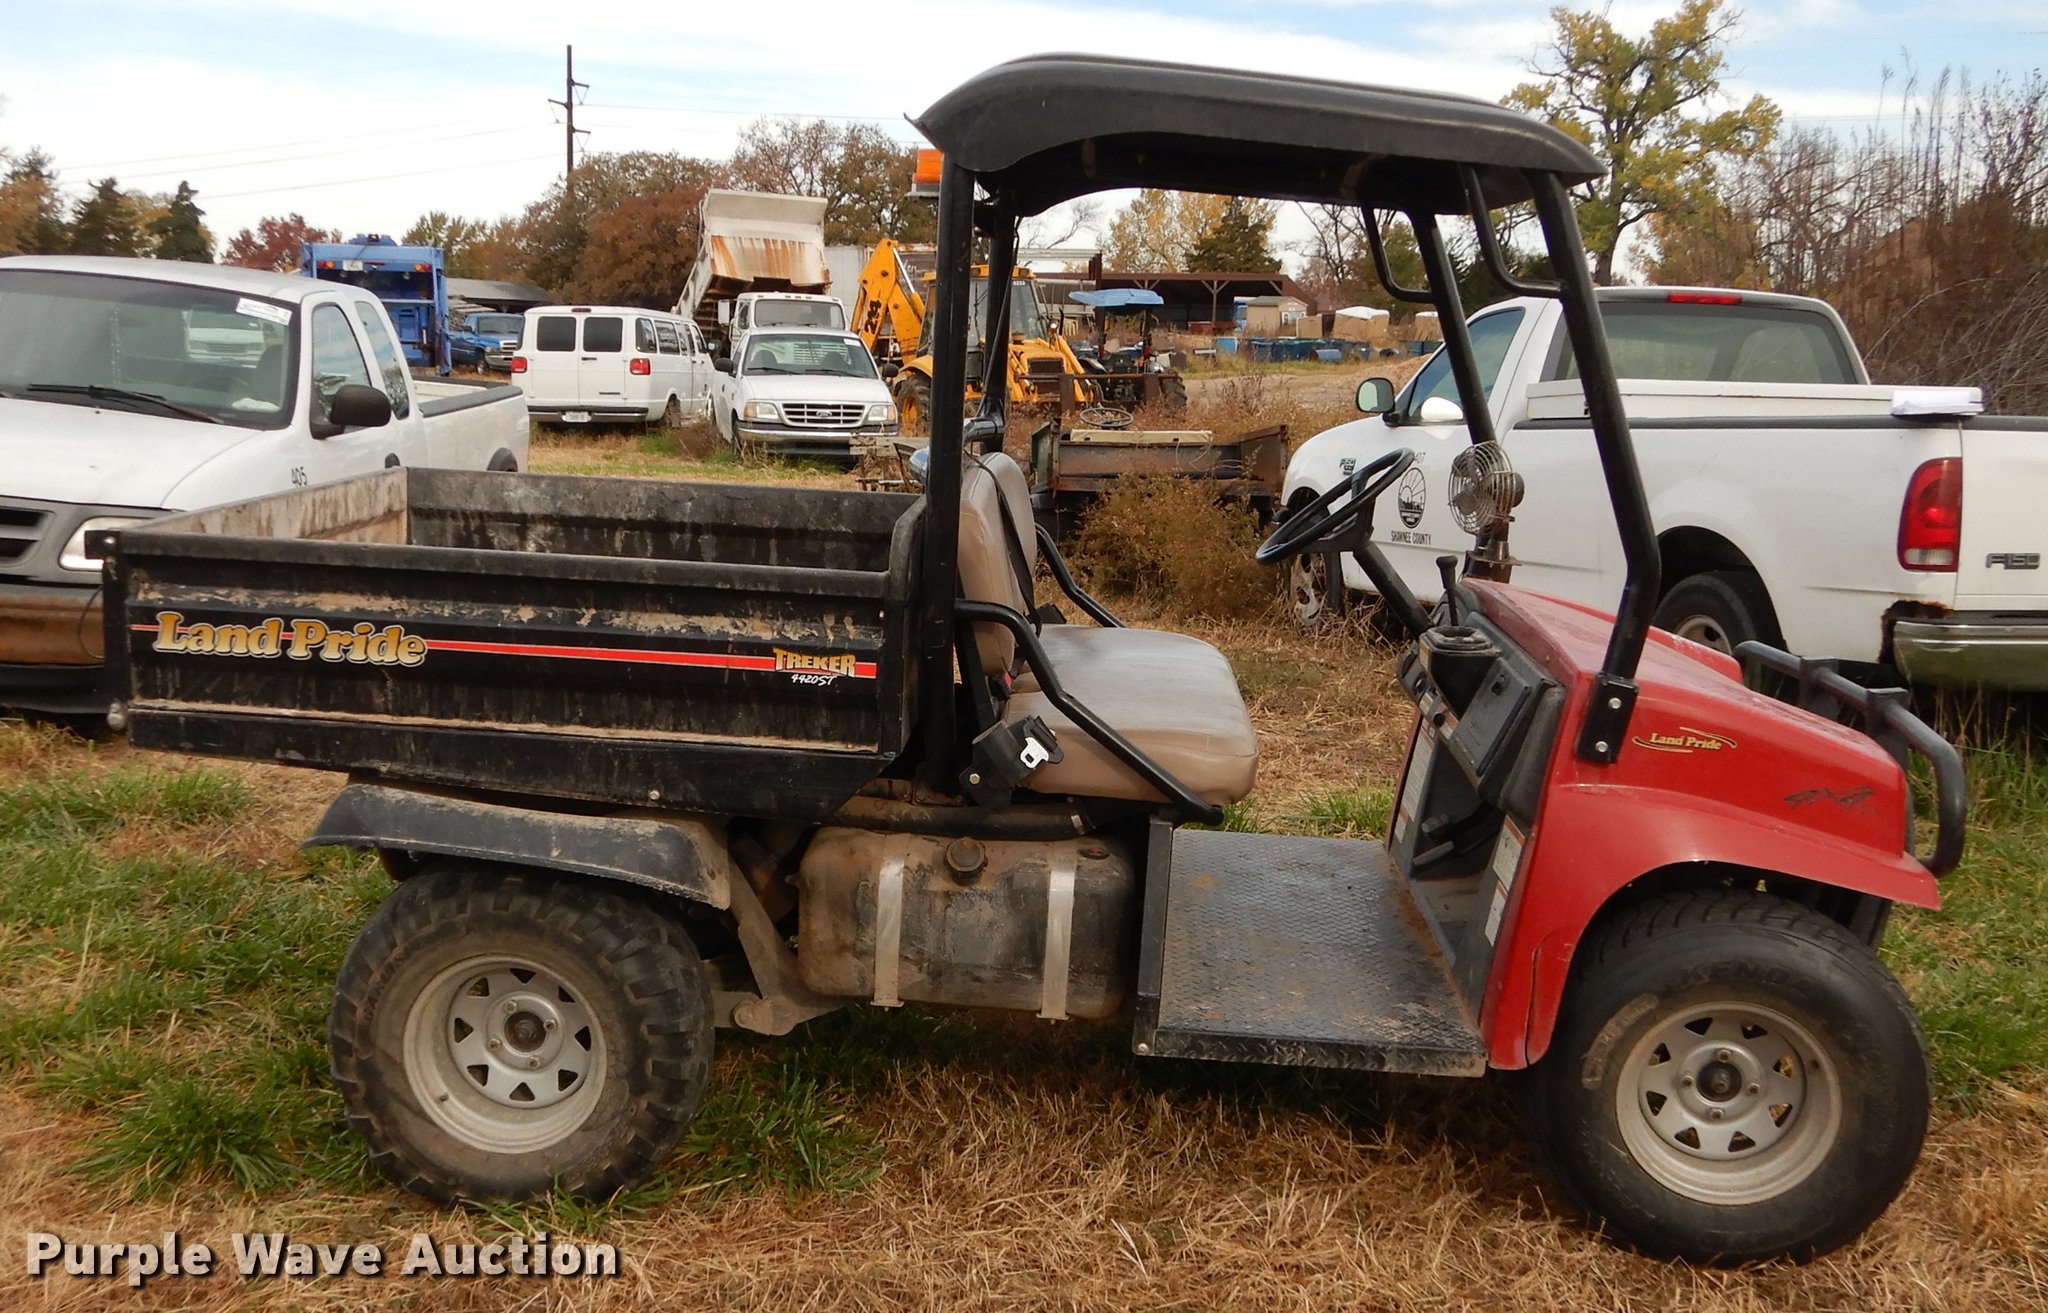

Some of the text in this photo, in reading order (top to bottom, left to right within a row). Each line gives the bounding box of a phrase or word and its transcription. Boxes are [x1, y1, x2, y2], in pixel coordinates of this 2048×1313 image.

[291, 466, 307, 486] 405
[1391, 530, 1431, 545] SHAWNEE COUNTY
[153, 611, 428, 667] Land Pride
[773, 647, 856, 678] TREKER
[1650, 732, 1723, 750] Land Pride
